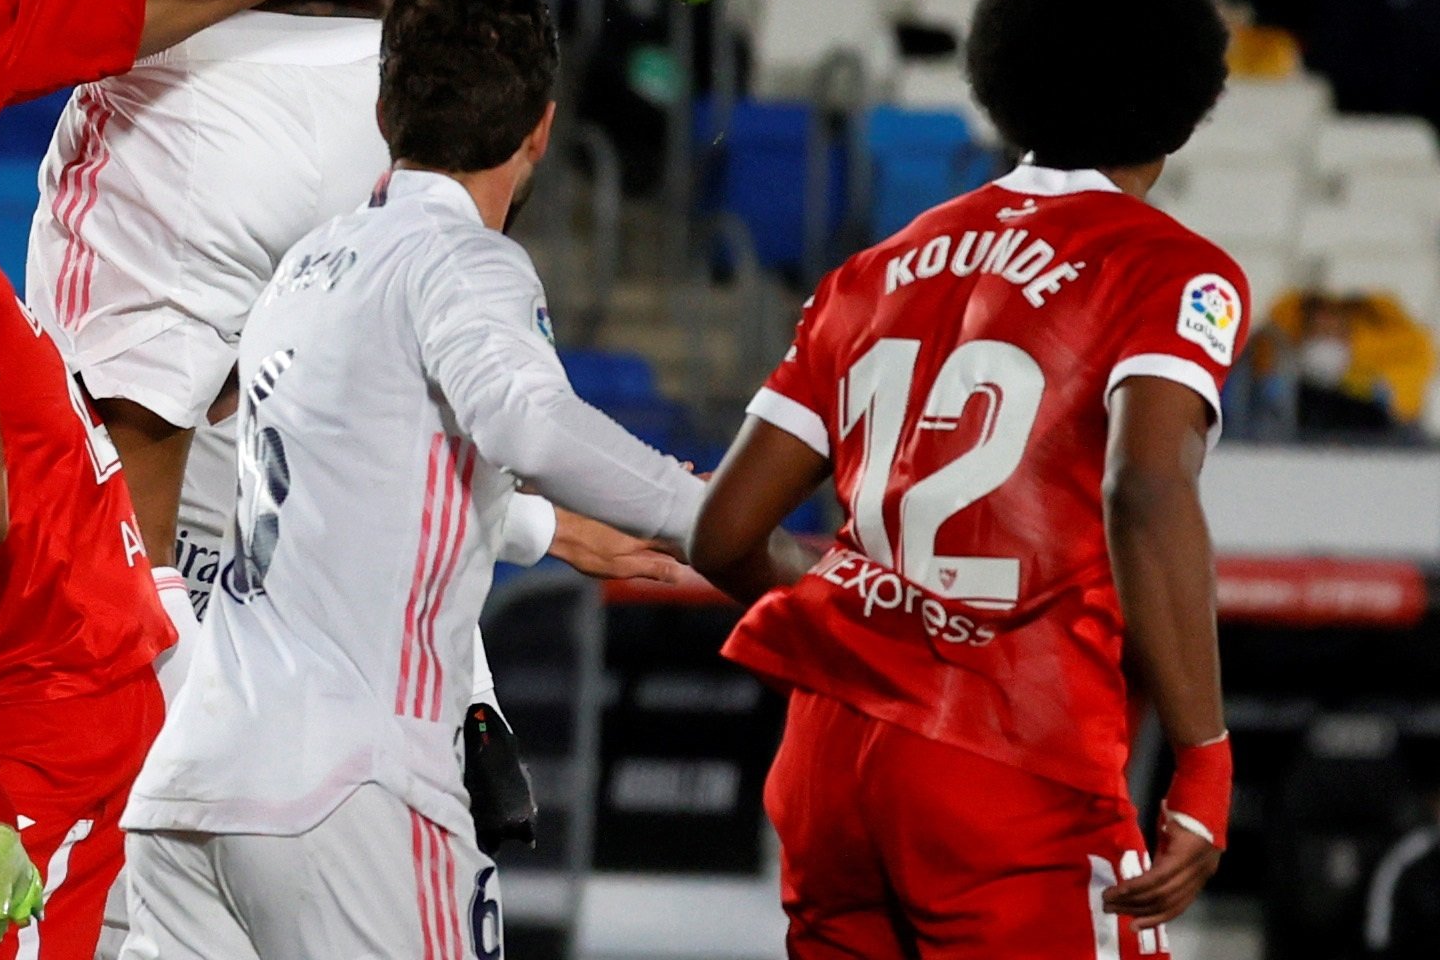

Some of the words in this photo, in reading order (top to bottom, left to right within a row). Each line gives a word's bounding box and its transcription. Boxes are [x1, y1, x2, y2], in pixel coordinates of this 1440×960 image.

[883, 228, 1086, 309] KOUNDÉ
[837, 338, 1047, 612] 12
[467, 865, 501, 960] 6
